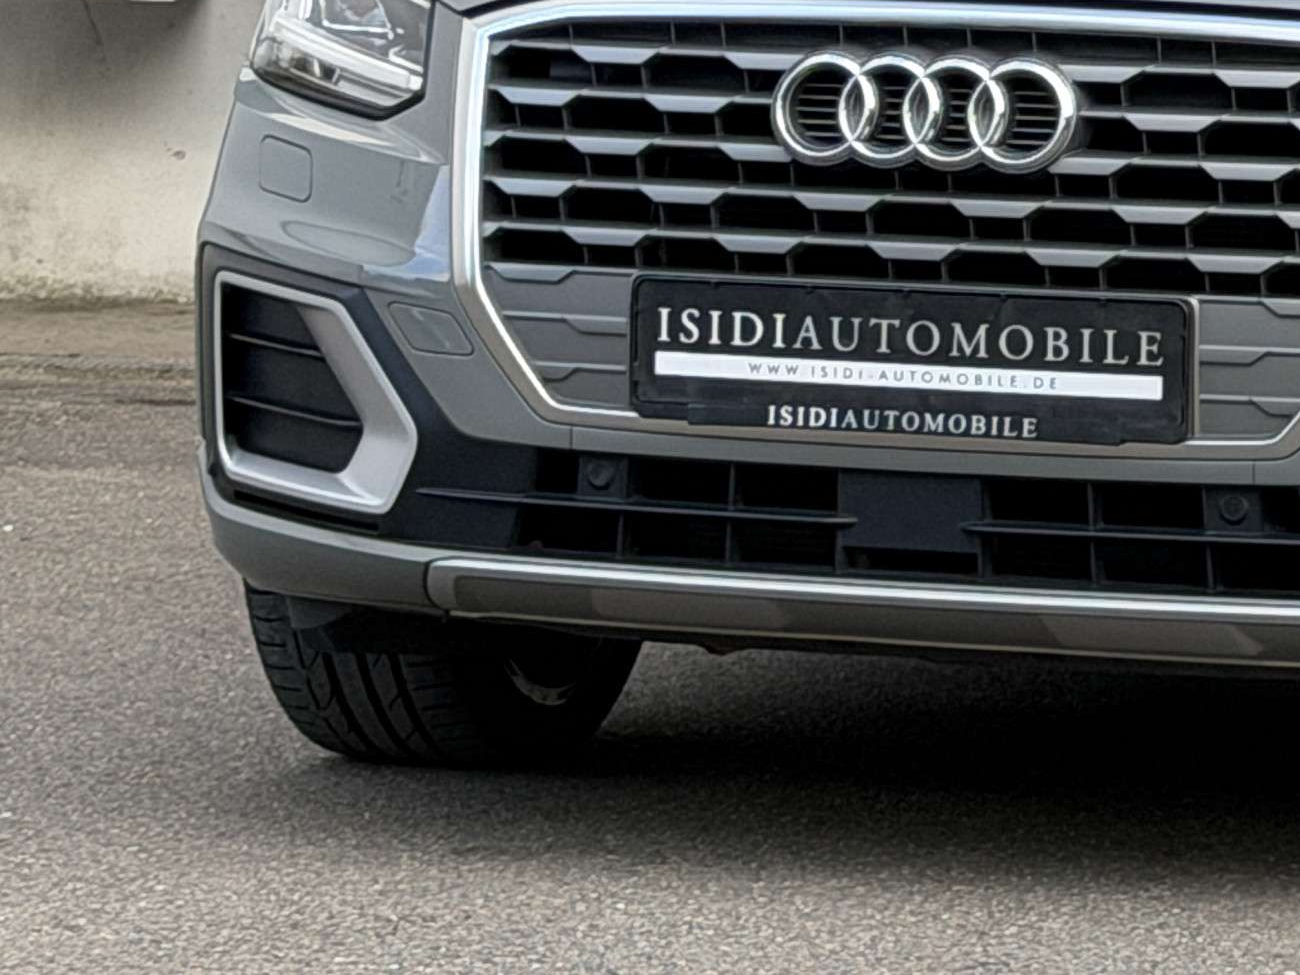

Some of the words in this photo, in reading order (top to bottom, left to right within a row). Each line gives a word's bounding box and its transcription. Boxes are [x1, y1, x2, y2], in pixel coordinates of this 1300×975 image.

[656, 306, 1165, 367] ISIDIAUTOMOBILE
[748, 362, 1058, 390] WWWISIDI-AUTOMOBILE.DE
[766, 404, 1039, 439] ISIDIAUTOMOBILE
